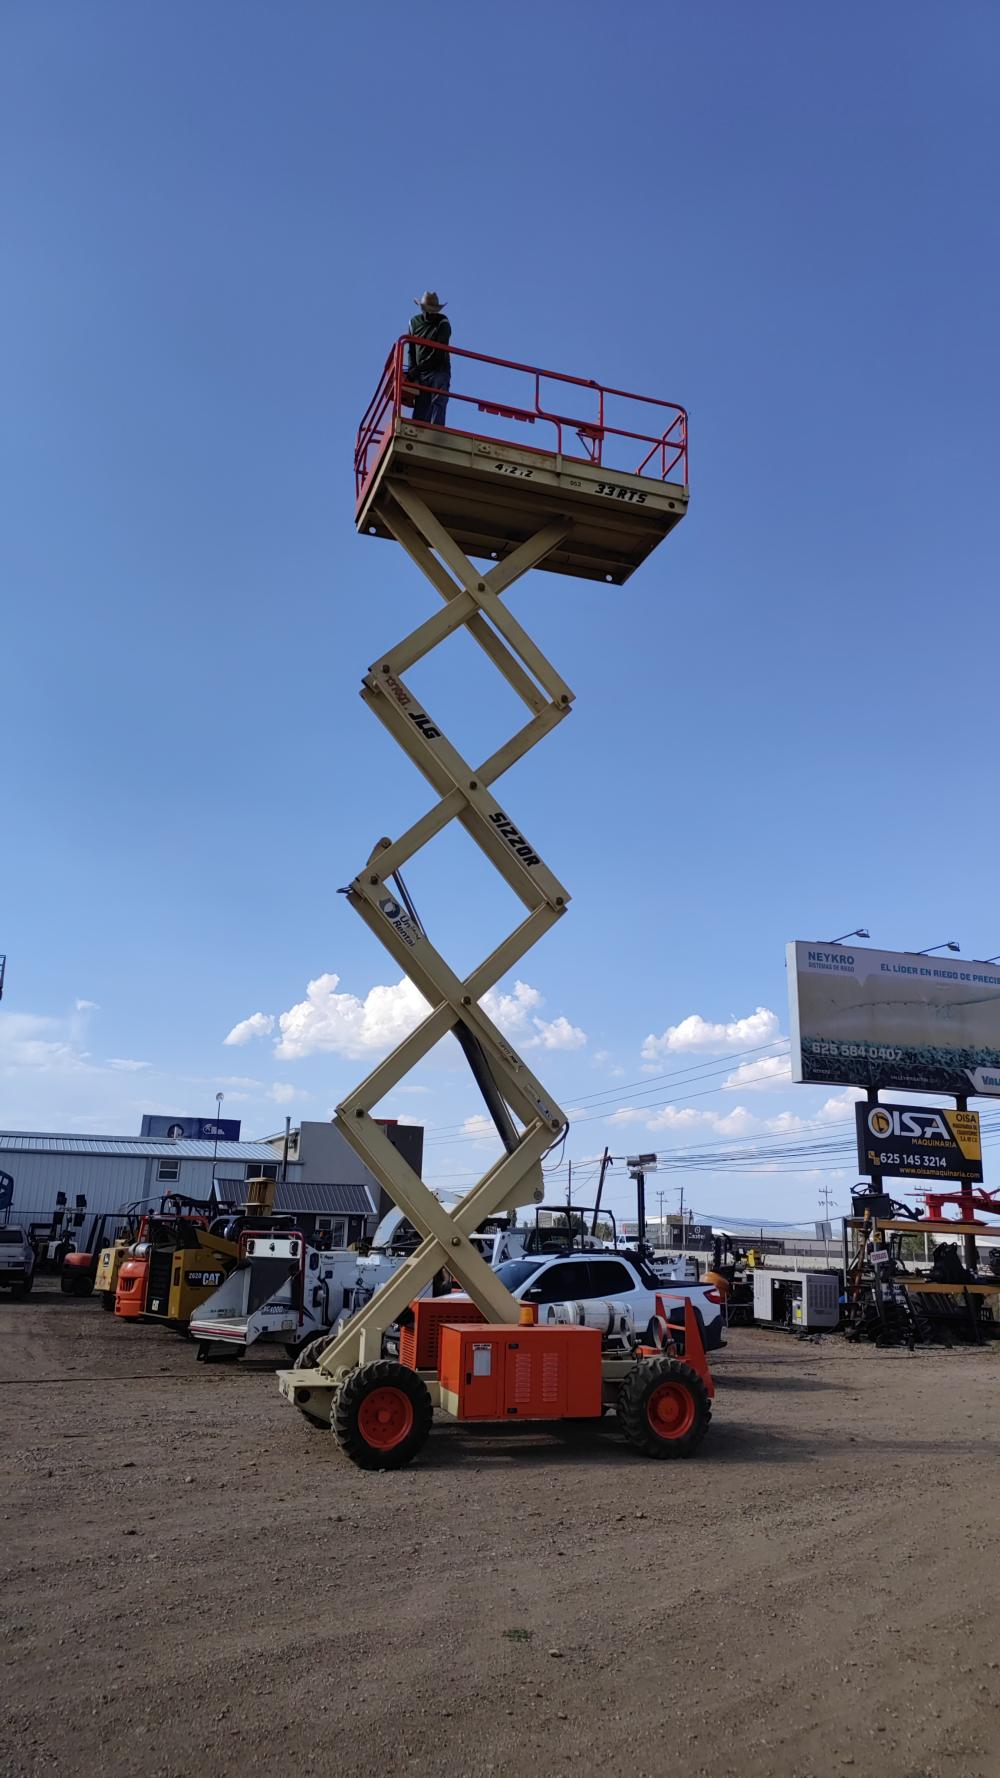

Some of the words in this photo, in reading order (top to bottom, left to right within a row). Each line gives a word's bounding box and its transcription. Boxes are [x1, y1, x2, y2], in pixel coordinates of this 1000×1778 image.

[408, 712, 441, 740] JLG
[488, 812, 541, 867] SIZZOR
[392, 919, 416, 947] Rental
[808, 951, 855, 965] NEYKRO
[880, 963, 891, 972] EL
[892, 963, 918, 976] LÍDER
[919, 968, 932, 977] EN
[933, 969, 959, 981] RIEGO
[960, 972, 972, 981] DE
[812, 1042, 838, 1055] 625
[867, 1107, 951, 1140] OISA
[955, 1113, 977, 1123] OISA
[911, 1138, 957, 1148] MAQUINARIA
[880, 1152, 900, 1163] 625
[902, 1154, 921, 1166] 145
[923, 1156, 947, 1167] 3214
[899, 1166, 980, 1179] www.oisamaquinaria.com
[202, 1272, 221, 1286] CAT
